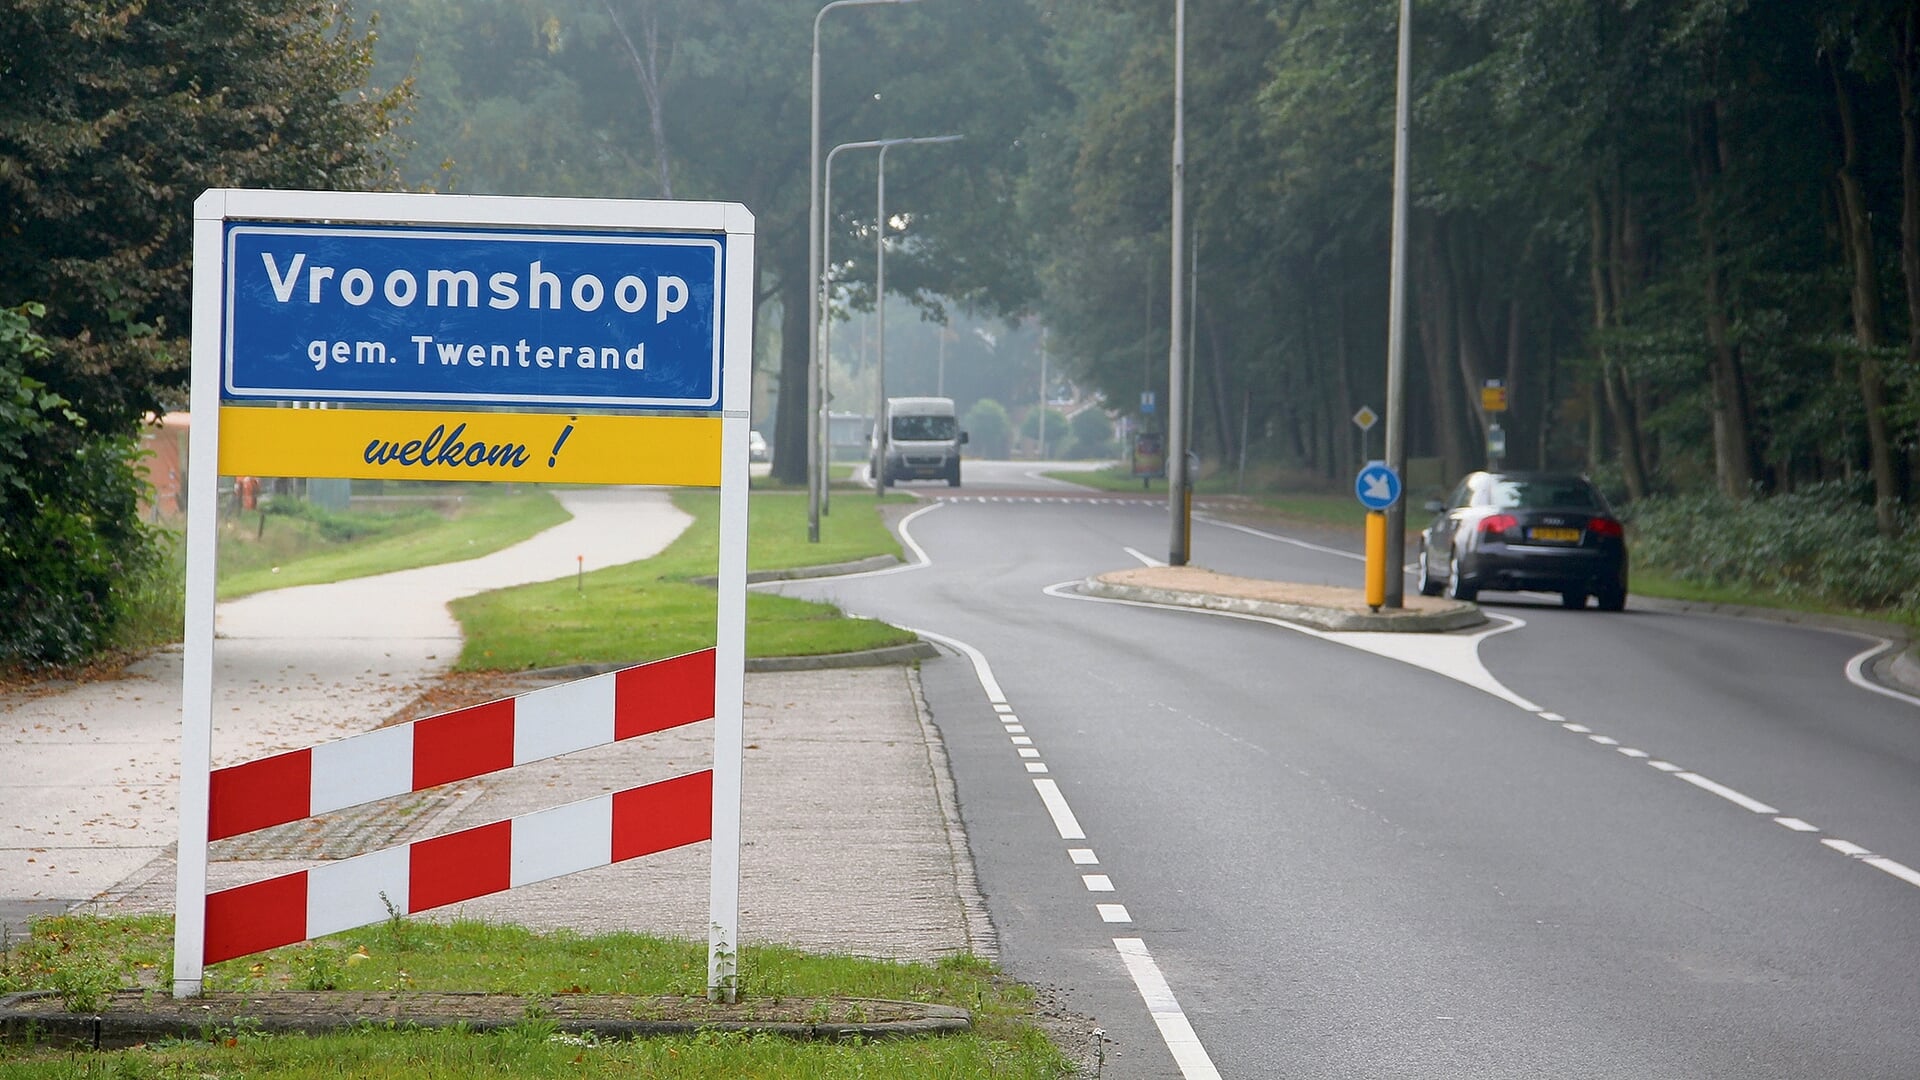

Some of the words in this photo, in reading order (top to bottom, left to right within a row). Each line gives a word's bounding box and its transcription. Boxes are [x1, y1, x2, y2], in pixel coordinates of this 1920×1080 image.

[261, 252, 690, 324] Vroomshoop
[307, 339, 397, 371] gem.
[411, 335, 645, 371] Twenterand
[363, 422, 530, 468] welkom
[547, 424, 574, 468] !
